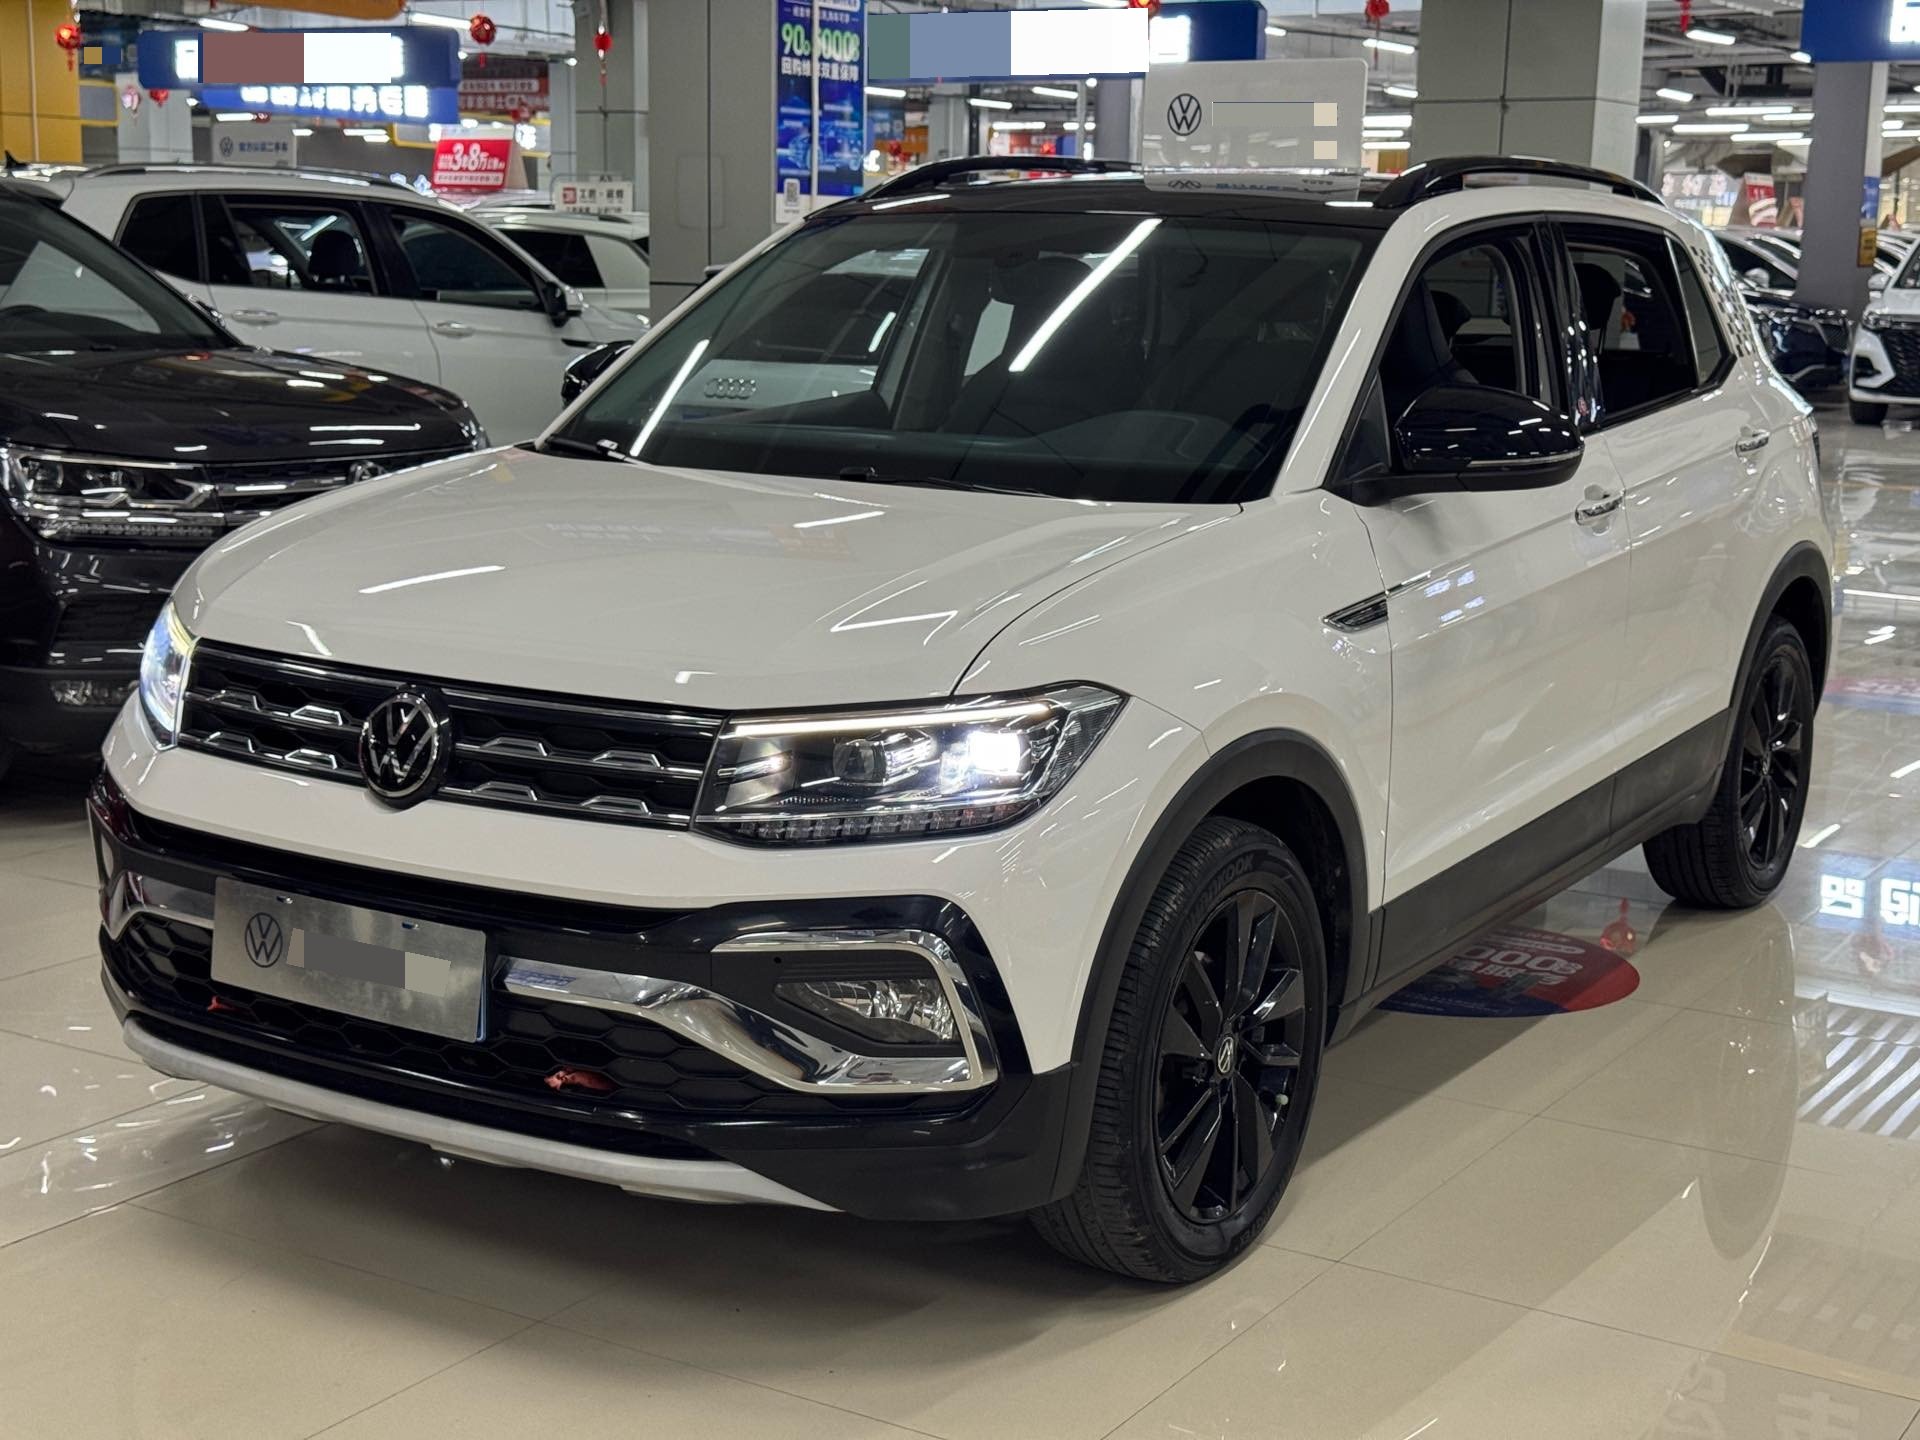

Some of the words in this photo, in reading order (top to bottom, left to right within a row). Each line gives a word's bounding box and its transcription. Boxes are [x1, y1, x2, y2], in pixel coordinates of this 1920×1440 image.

[781, 57, 859, 82] 回购维双重保障
